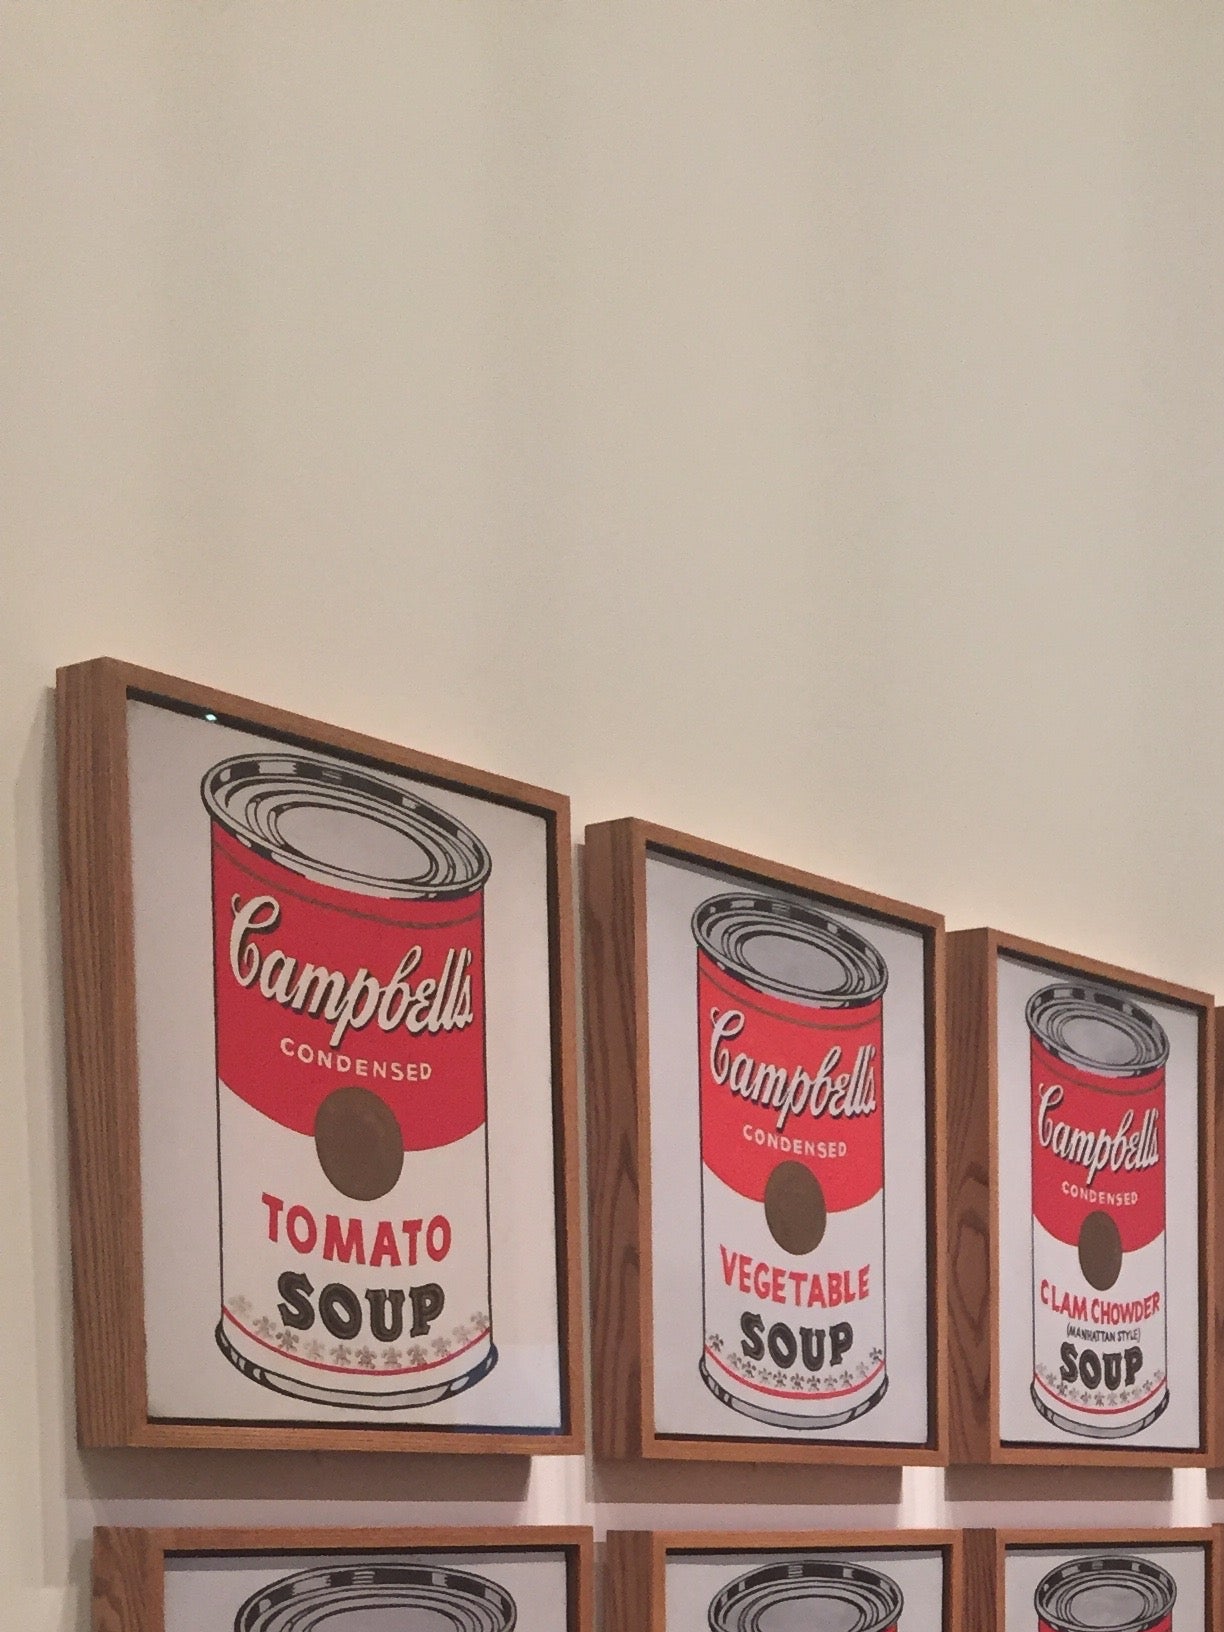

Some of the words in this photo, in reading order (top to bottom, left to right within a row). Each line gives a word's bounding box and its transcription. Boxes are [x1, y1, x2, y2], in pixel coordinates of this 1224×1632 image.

[229, 893, 474, 1047] Campbell's
[280, 1037, 433, 1082] CONDENSED
[710, 1007, 877, 1129] Campbell's
[743, 1124, 847, 1158] CONDENSED
[1037, 1083, 1159, 1185] Campbell's
[1061, 1181, 1138, 1206] CONDENSED
[262, 1191, 452, 1267] TOMATO
[277, 1271, 445, 1341] SOUP
[720, 1244, 870, 1309] VEGETABLE
[1040, 1280, 1088, 1323] CLAM
[1091, 1291, 1160, 1326] CHOWDER
[740, 1311, 854, 1372] SOUP
[1059, 1341, 1143, 1390] SOUP
